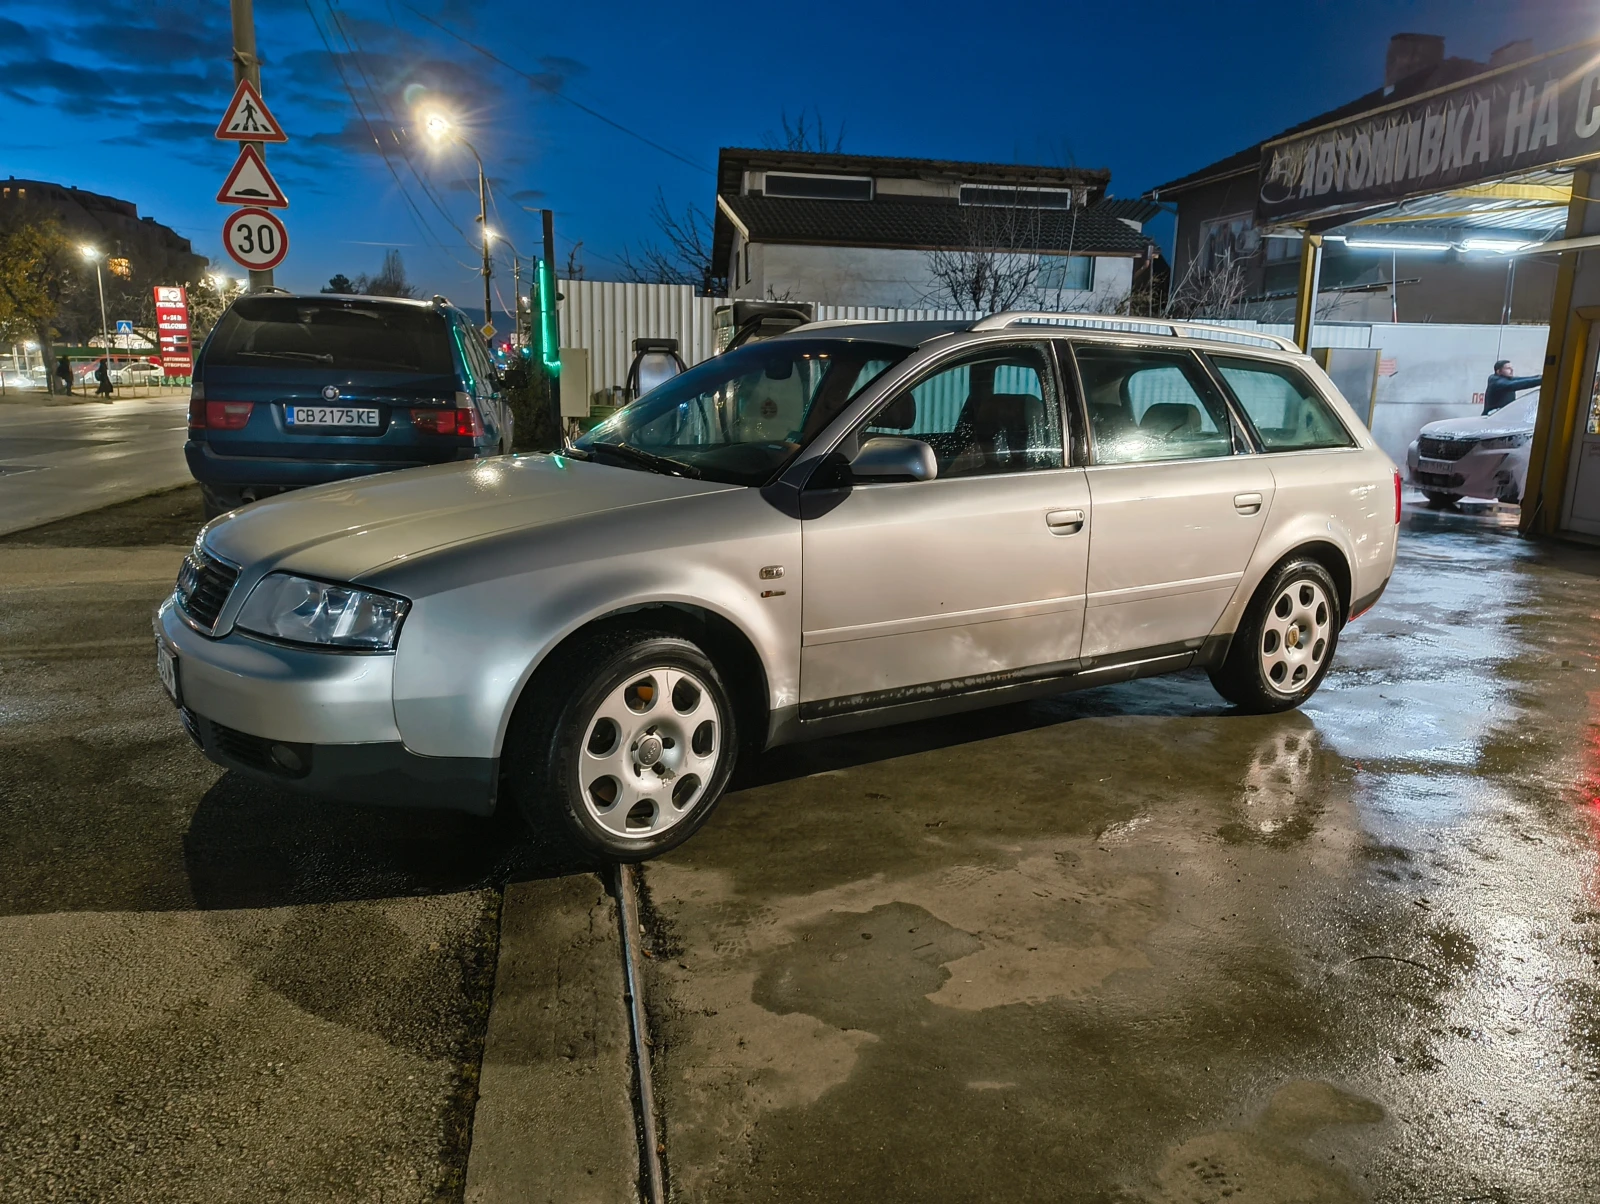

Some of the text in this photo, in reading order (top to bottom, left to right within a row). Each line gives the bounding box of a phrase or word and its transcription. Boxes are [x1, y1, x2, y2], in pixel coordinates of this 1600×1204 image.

[1299, 98, 1490, 199] АВТОМИВКА
[1503, 77, 1559, 158] НА
[237, 223, 275, 254] 30
[296, 408, 377, 424] CB 2175 KE
